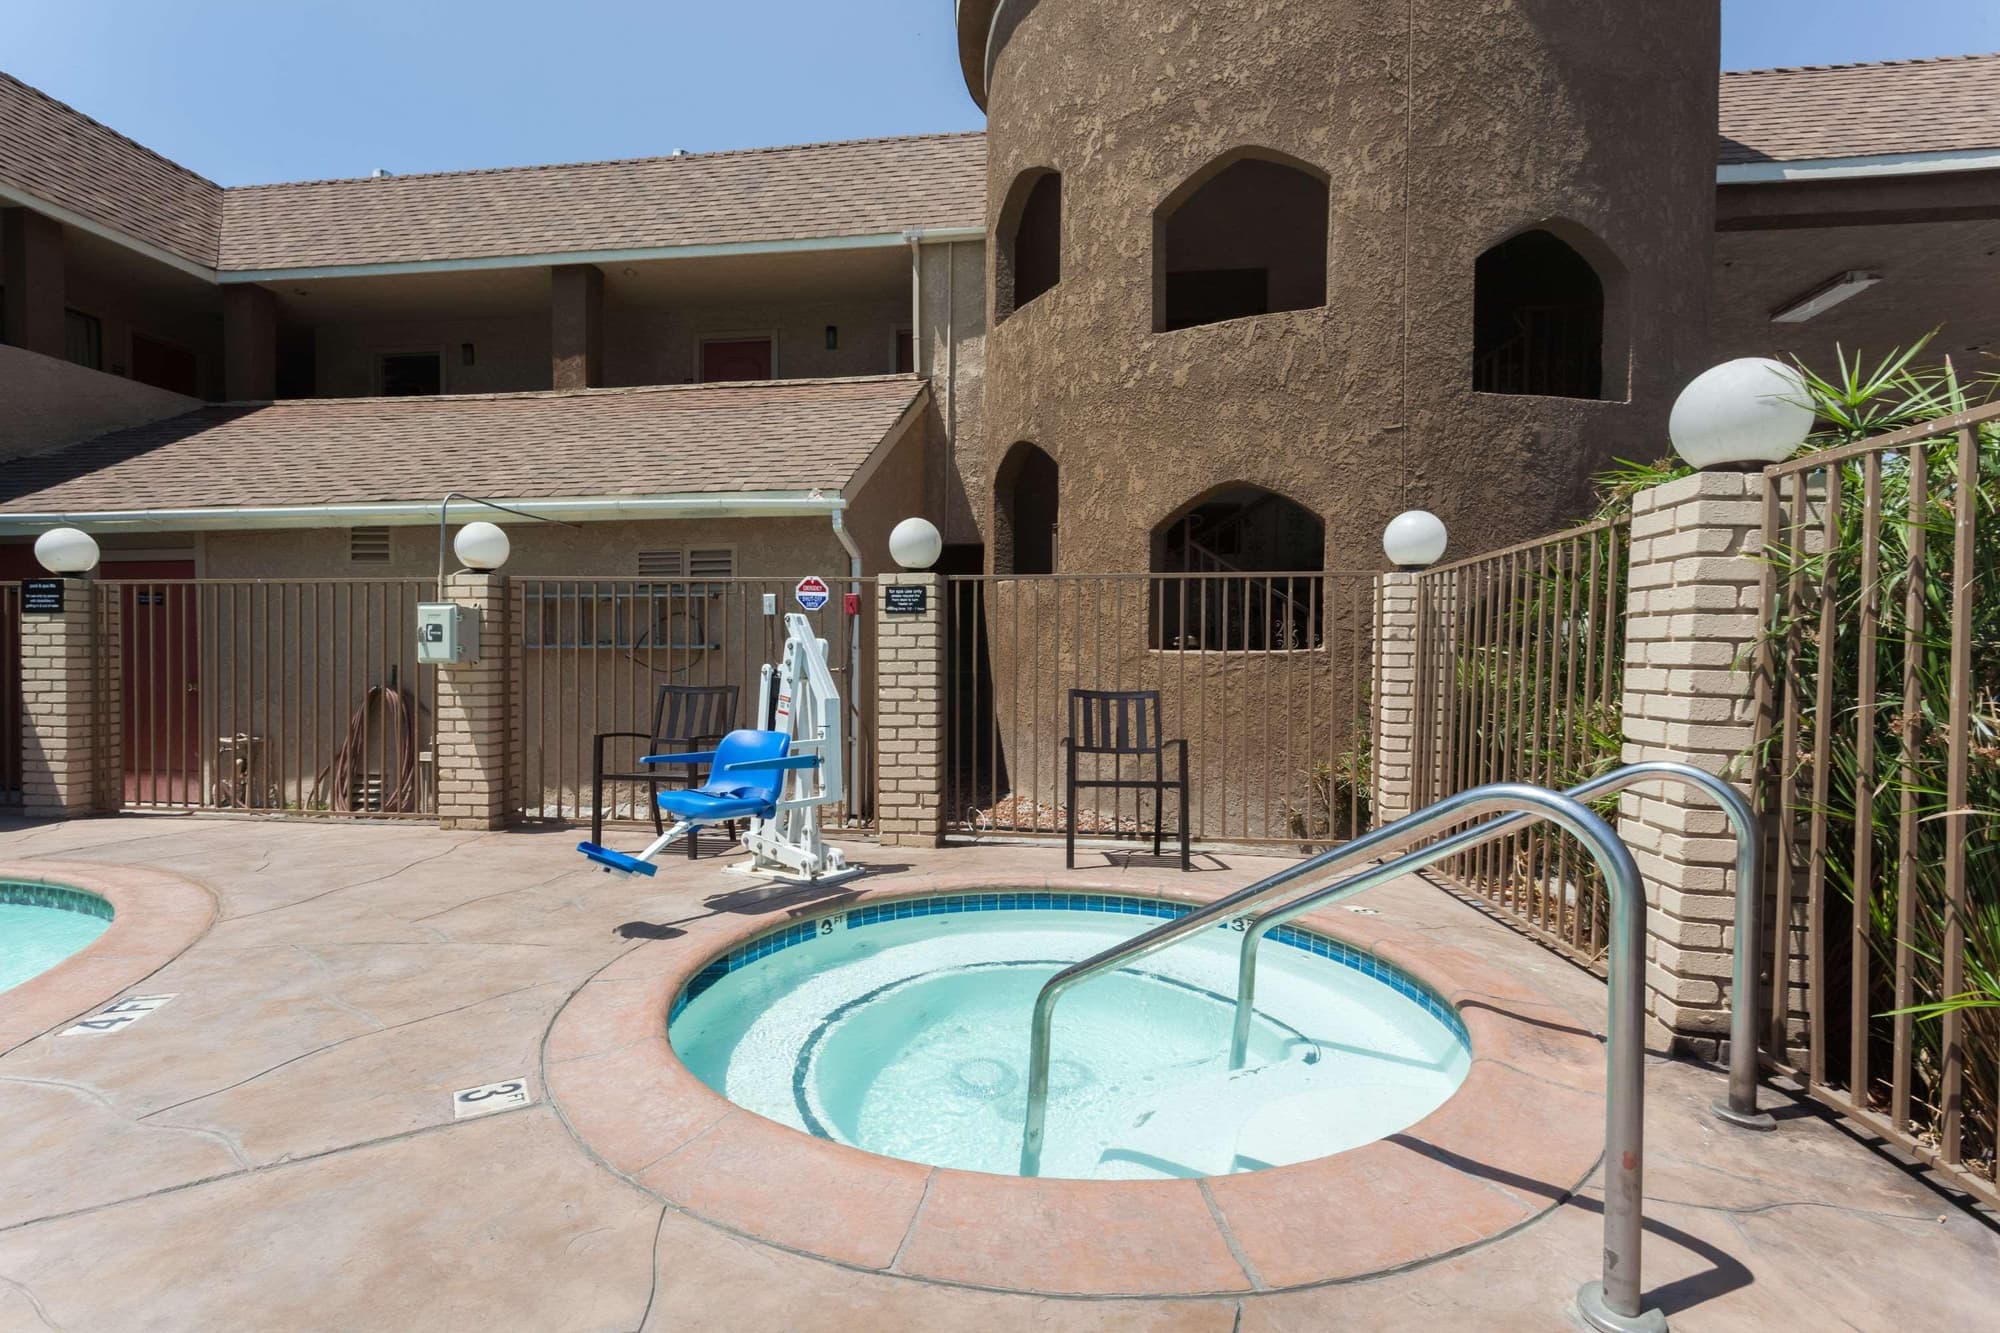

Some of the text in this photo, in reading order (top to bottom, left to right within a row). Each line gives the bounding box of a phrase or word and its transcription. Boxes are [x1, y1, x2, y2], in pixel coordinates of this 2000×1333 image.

[821, 915, 843, 935] 3 FT
[1231, 917, 1245, 932] 3
[79, 997, 170, 1030] 4 FT
[458, 1083, 525, 1103] 3 FT
